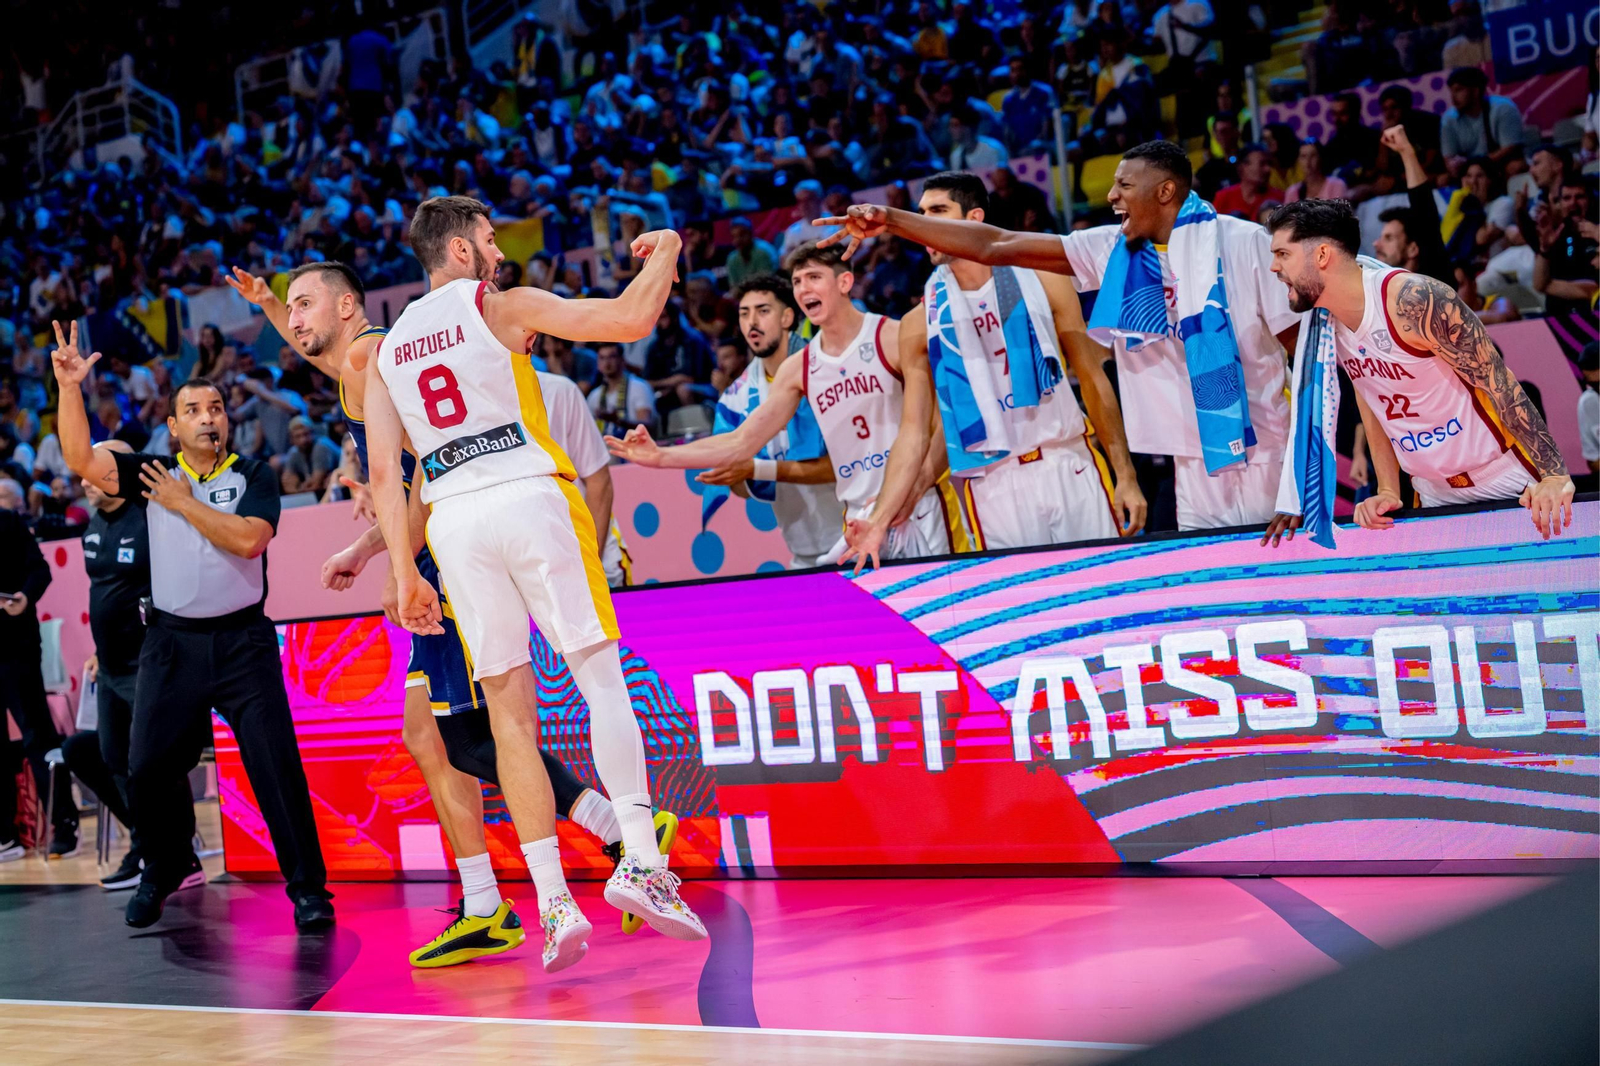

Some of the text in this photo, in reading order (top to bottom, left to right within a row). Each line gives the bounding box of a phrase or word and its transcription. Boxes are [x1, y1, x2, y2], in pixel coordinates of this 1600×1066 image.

[394, 325, 466, 366] BRIZUELA
[994, 347, 1009, 376] 7
[417, 364, 468, 429] 8
[816, 371, 884, 414] ESPAÑA
[1378, 394, 1420, 421] 22
[852, 415, 870, 439] 3
[1391, 416, 1463, 452] ndesa
[439, 428, 522, 467] CaixaBank
[693, 612, 1599, 771] DON'T MISS OUT
